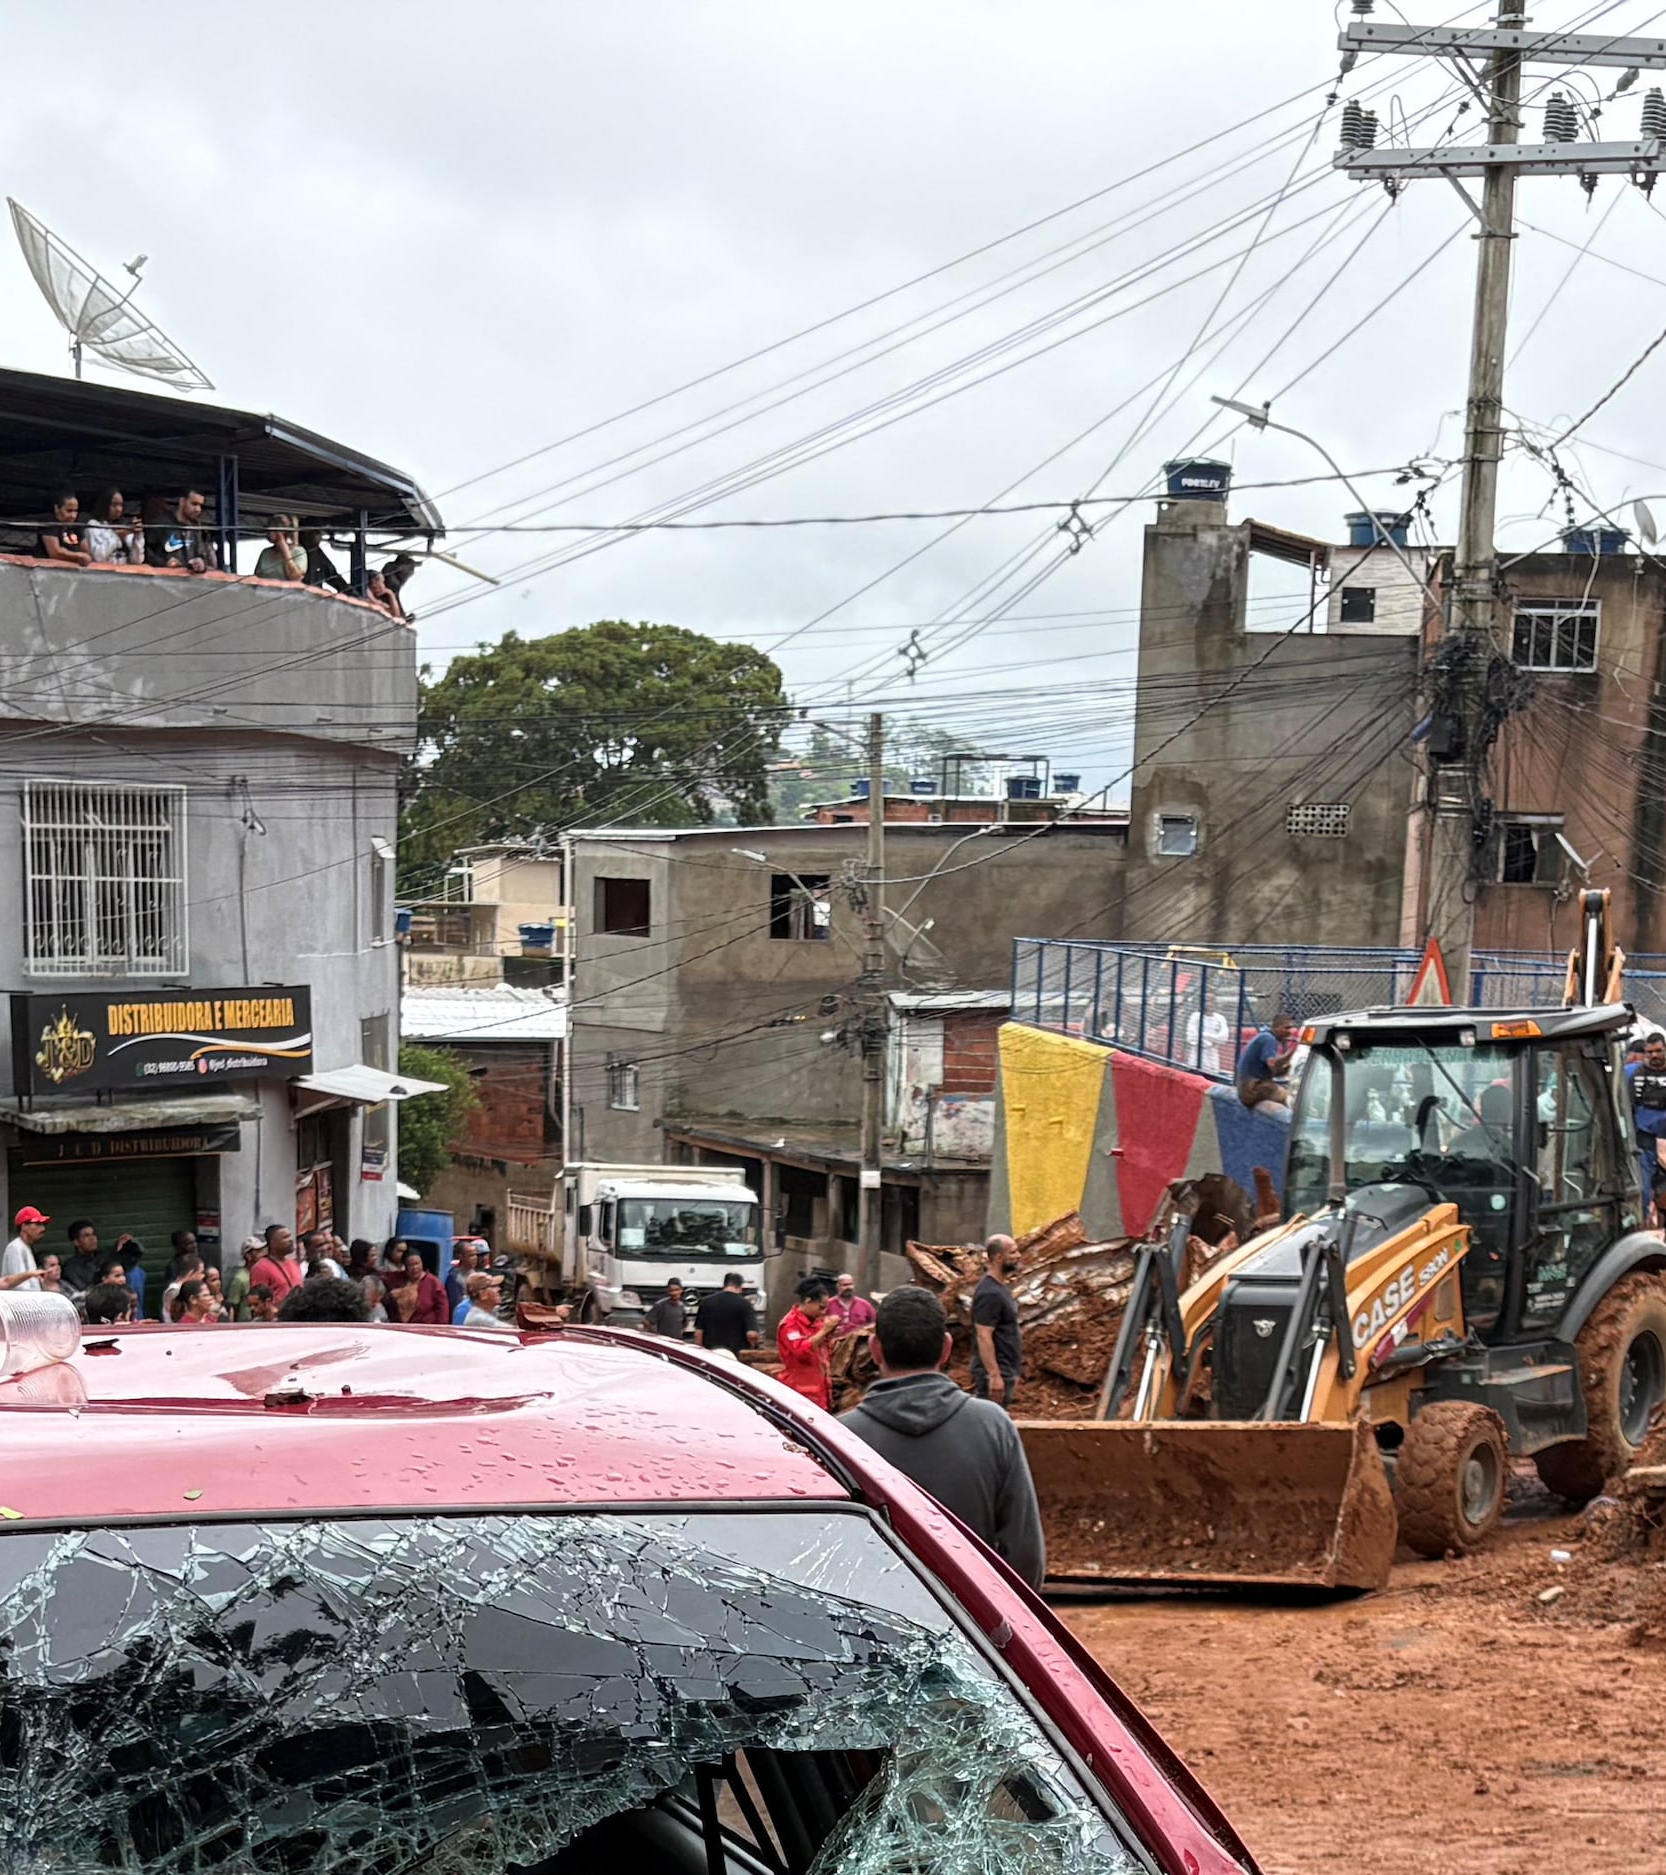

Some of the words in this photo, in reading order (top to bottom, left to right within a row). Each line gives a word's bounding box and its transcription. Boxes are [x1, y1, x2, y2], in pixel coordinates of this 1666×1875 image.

[108, 1001, 213, 1036] DISTRIBUIDORA
[214, 1000, 222, 1030] E
[224, 998, 295, 1029] MERCEARIA
[1353, 1265, 1415, 1348] CASE
